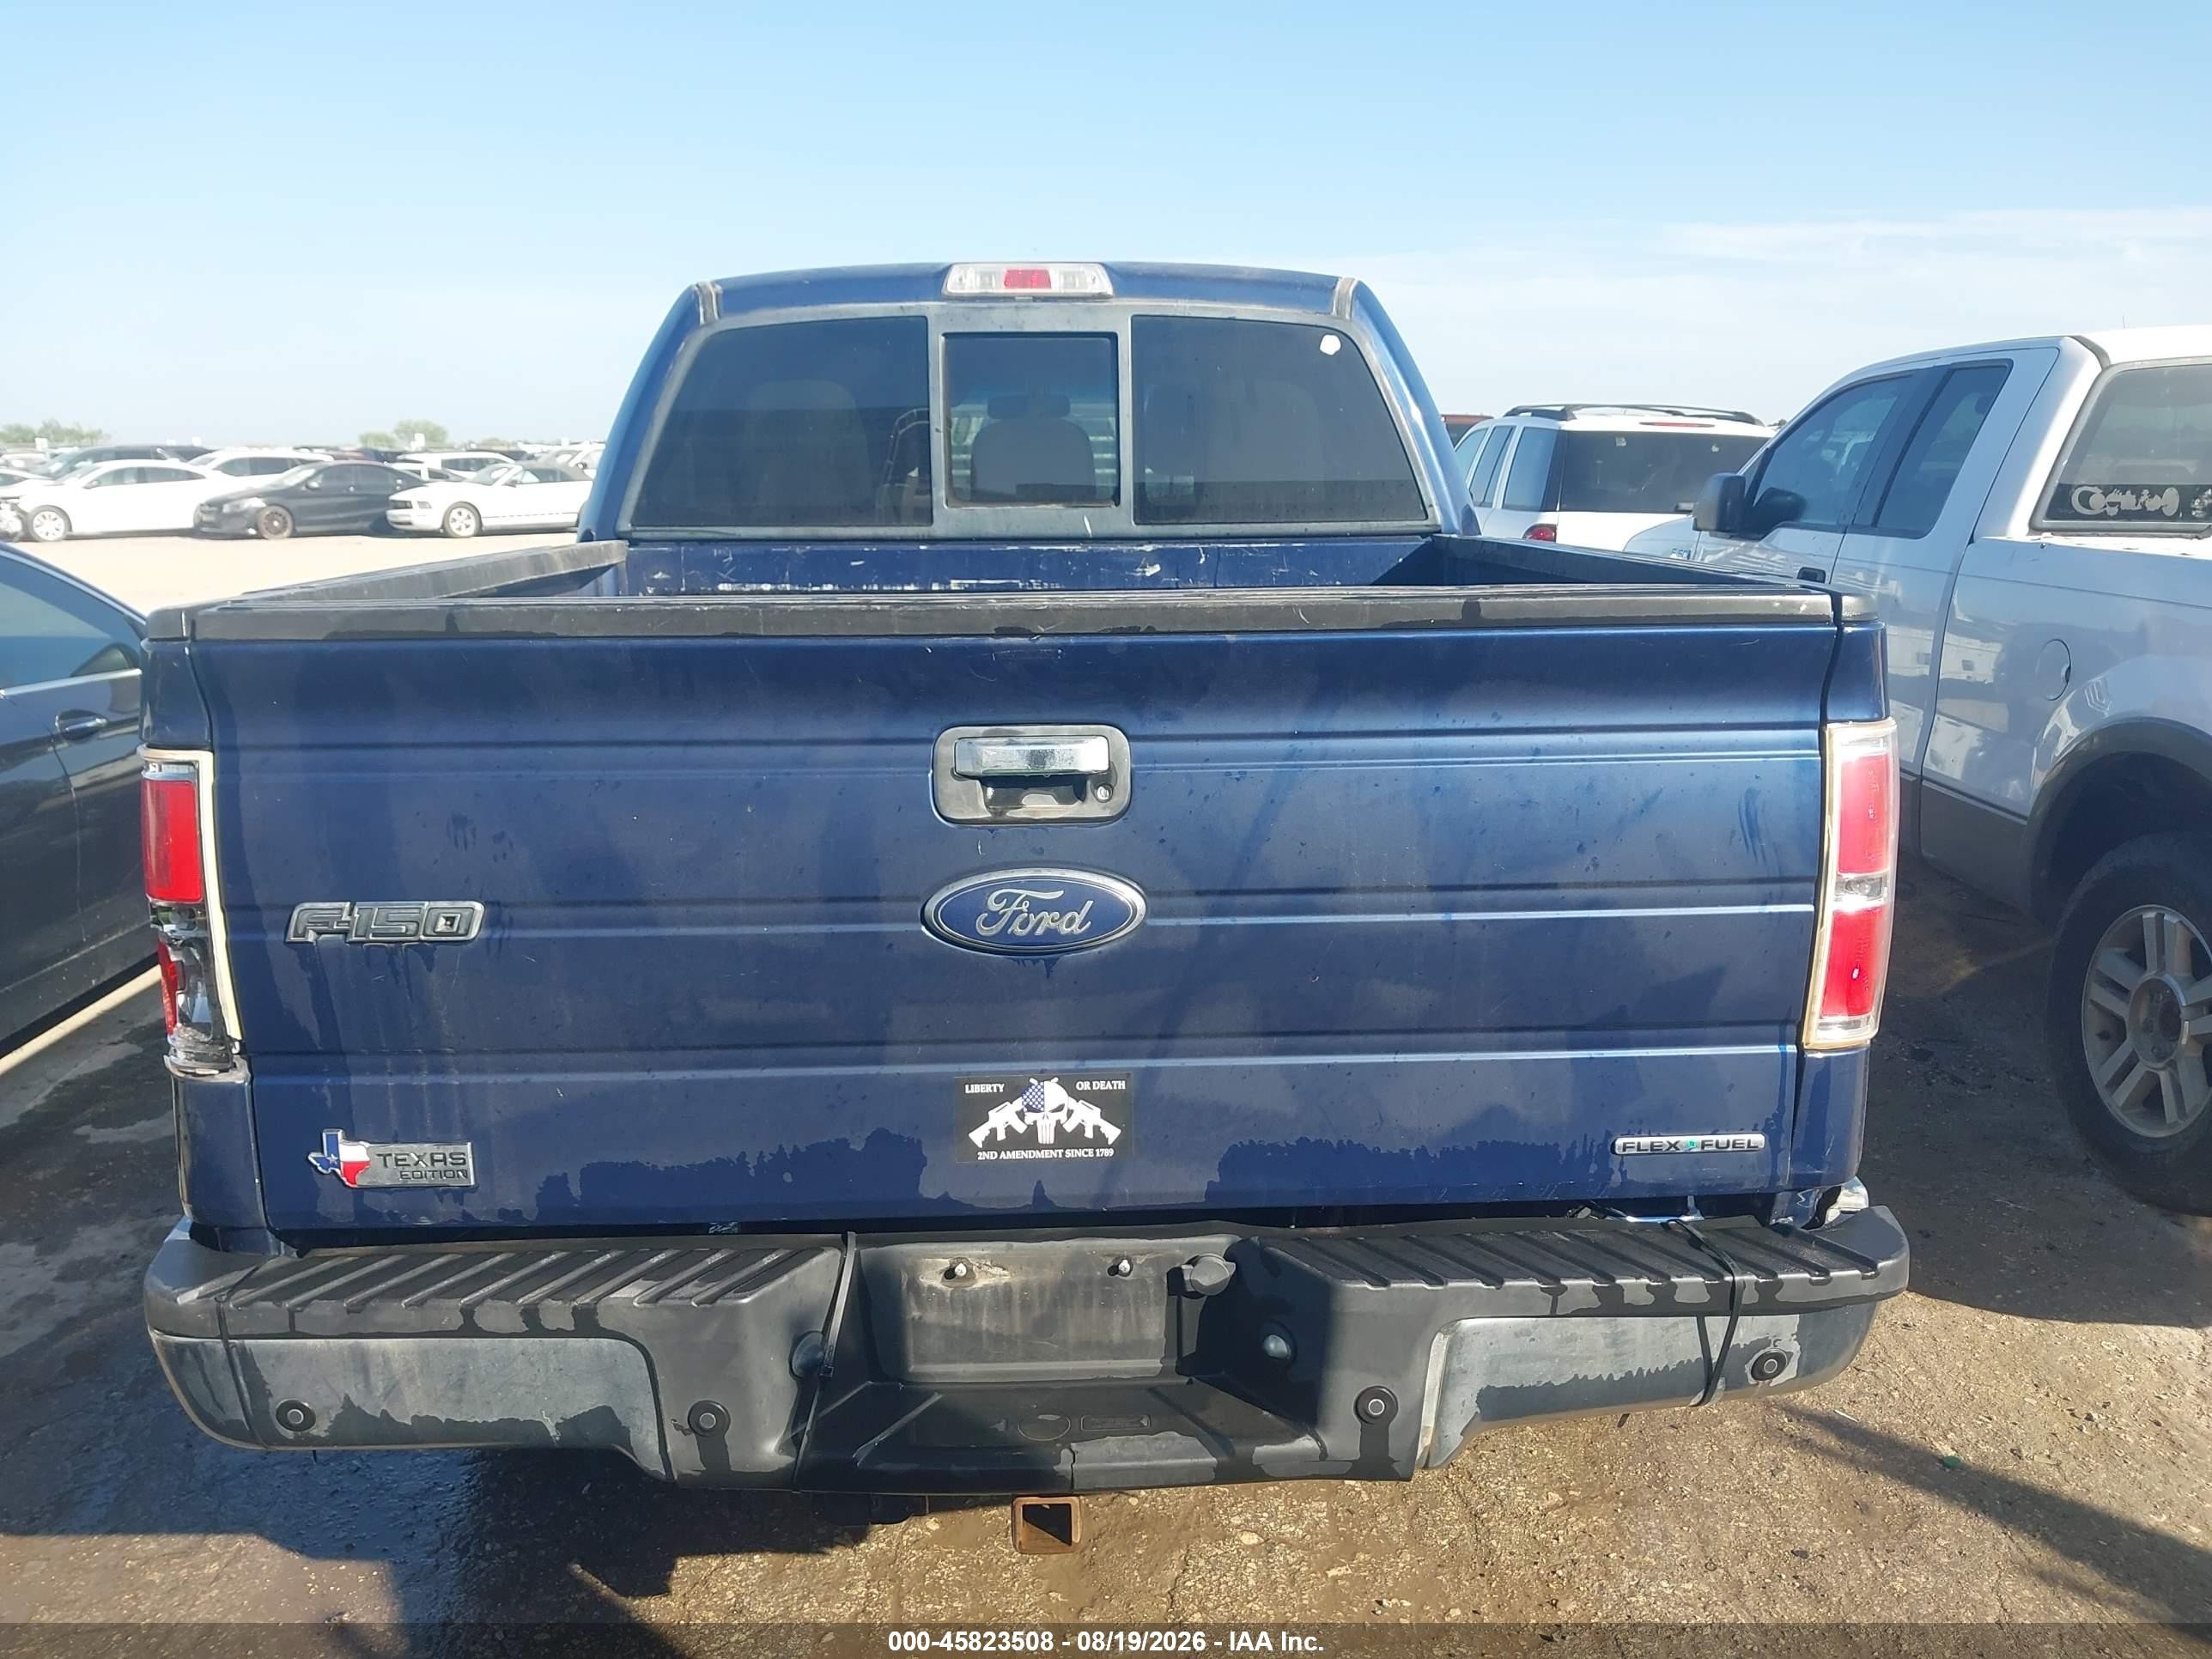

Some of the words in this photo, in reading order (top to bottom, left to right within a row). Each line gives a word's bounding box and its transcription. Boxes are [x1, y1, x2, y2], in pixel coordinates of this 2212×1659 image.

[975, 888, 1094, 937] Ford
[285, 901, 486, 945] F-150
[964, 1083, 1006, 1094] LIBERTY
[1075, 1081, 1091, 1091] OR
[1092, 1080, 1126, 1091] DEATH
[1621, 1140, 1680, 1152] FLEX
[1699, 1139, 1759, 1151] FUEL
[376, 1152, 467, 1168] TEXAS
[976, 1151, 999, 1160] 2ND
[999, 1149, 1065, 1160] AMENDMENT
[1065, 1148, 1095, 1158] SINCE
[1095, 1147, 1115, 1158] 1789
[399, 1169, 469, 1181] EDITION
